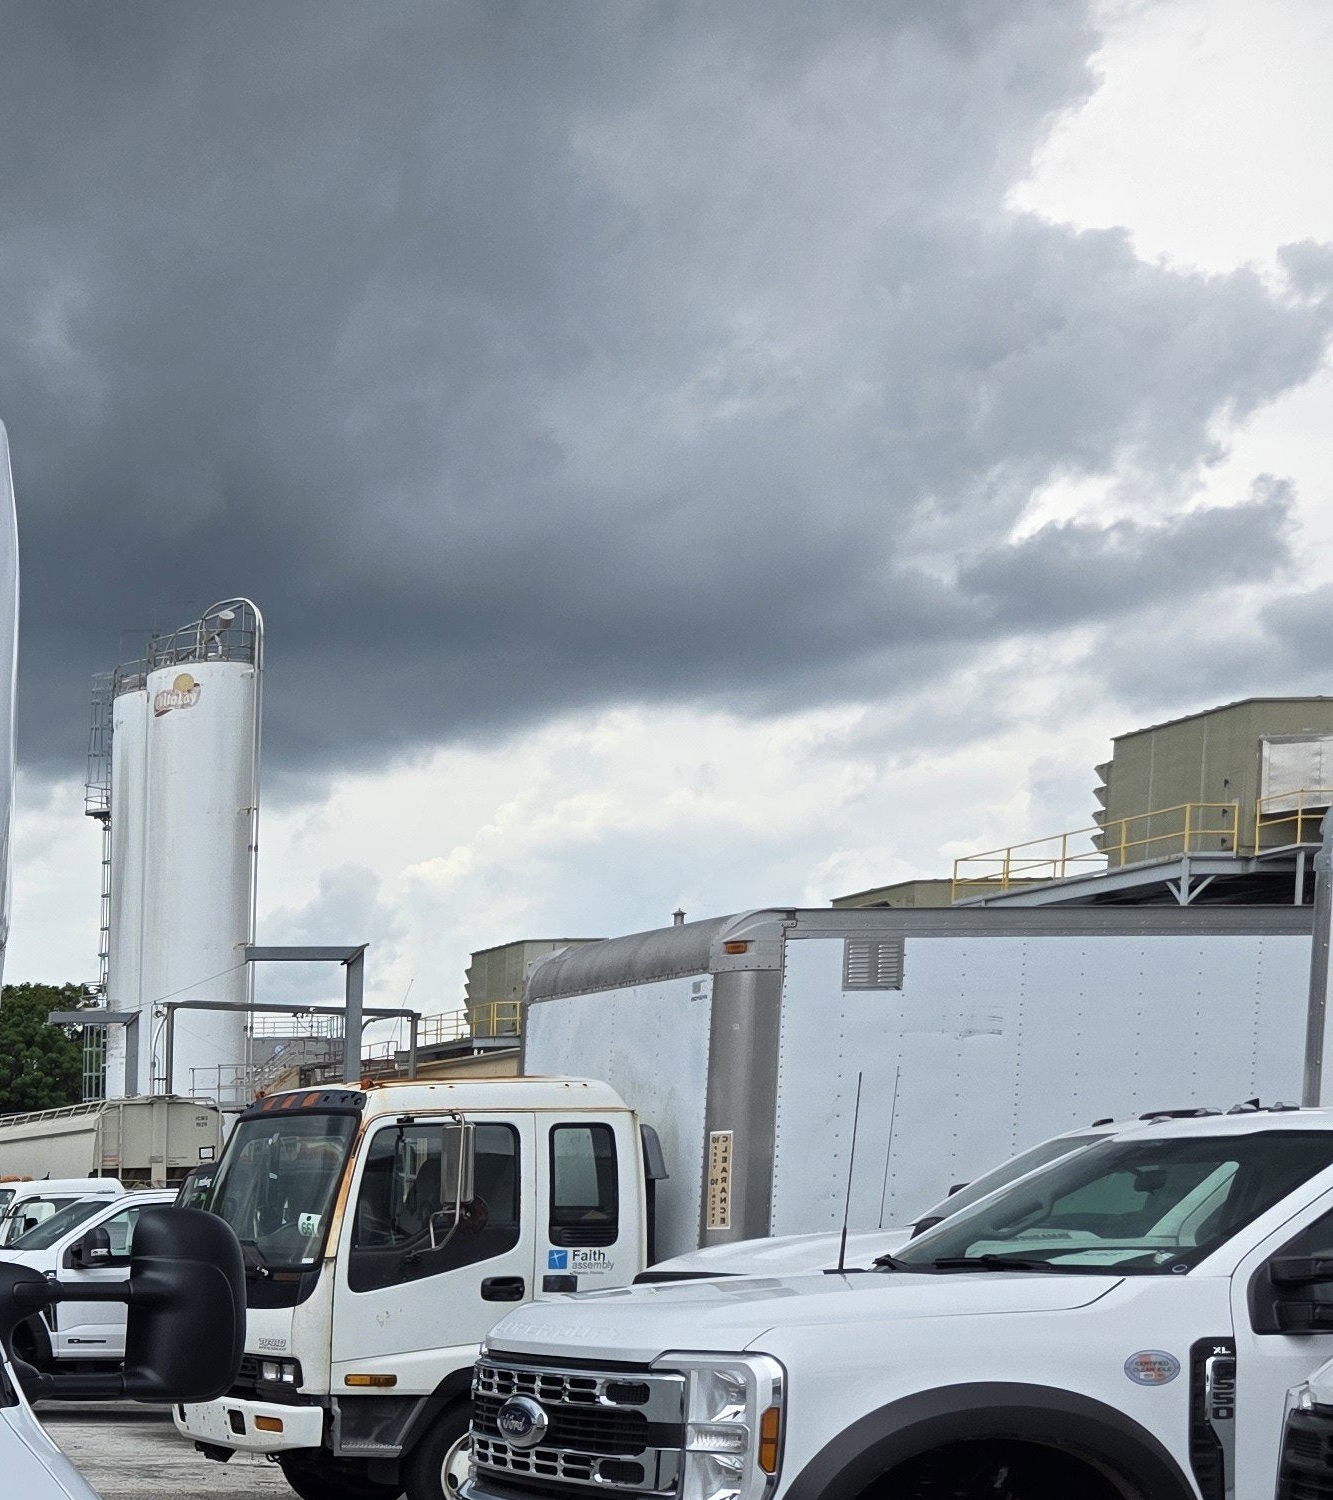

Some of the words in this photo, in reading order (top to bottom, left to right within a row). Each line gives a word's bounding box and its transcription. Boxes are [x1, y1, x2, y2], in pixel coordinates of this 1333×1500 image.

[572, 1249, 606, 1262] Faith
[571, 1260, 614, 1271] assembly
[1213, 1346, 1231, 1354] XL
